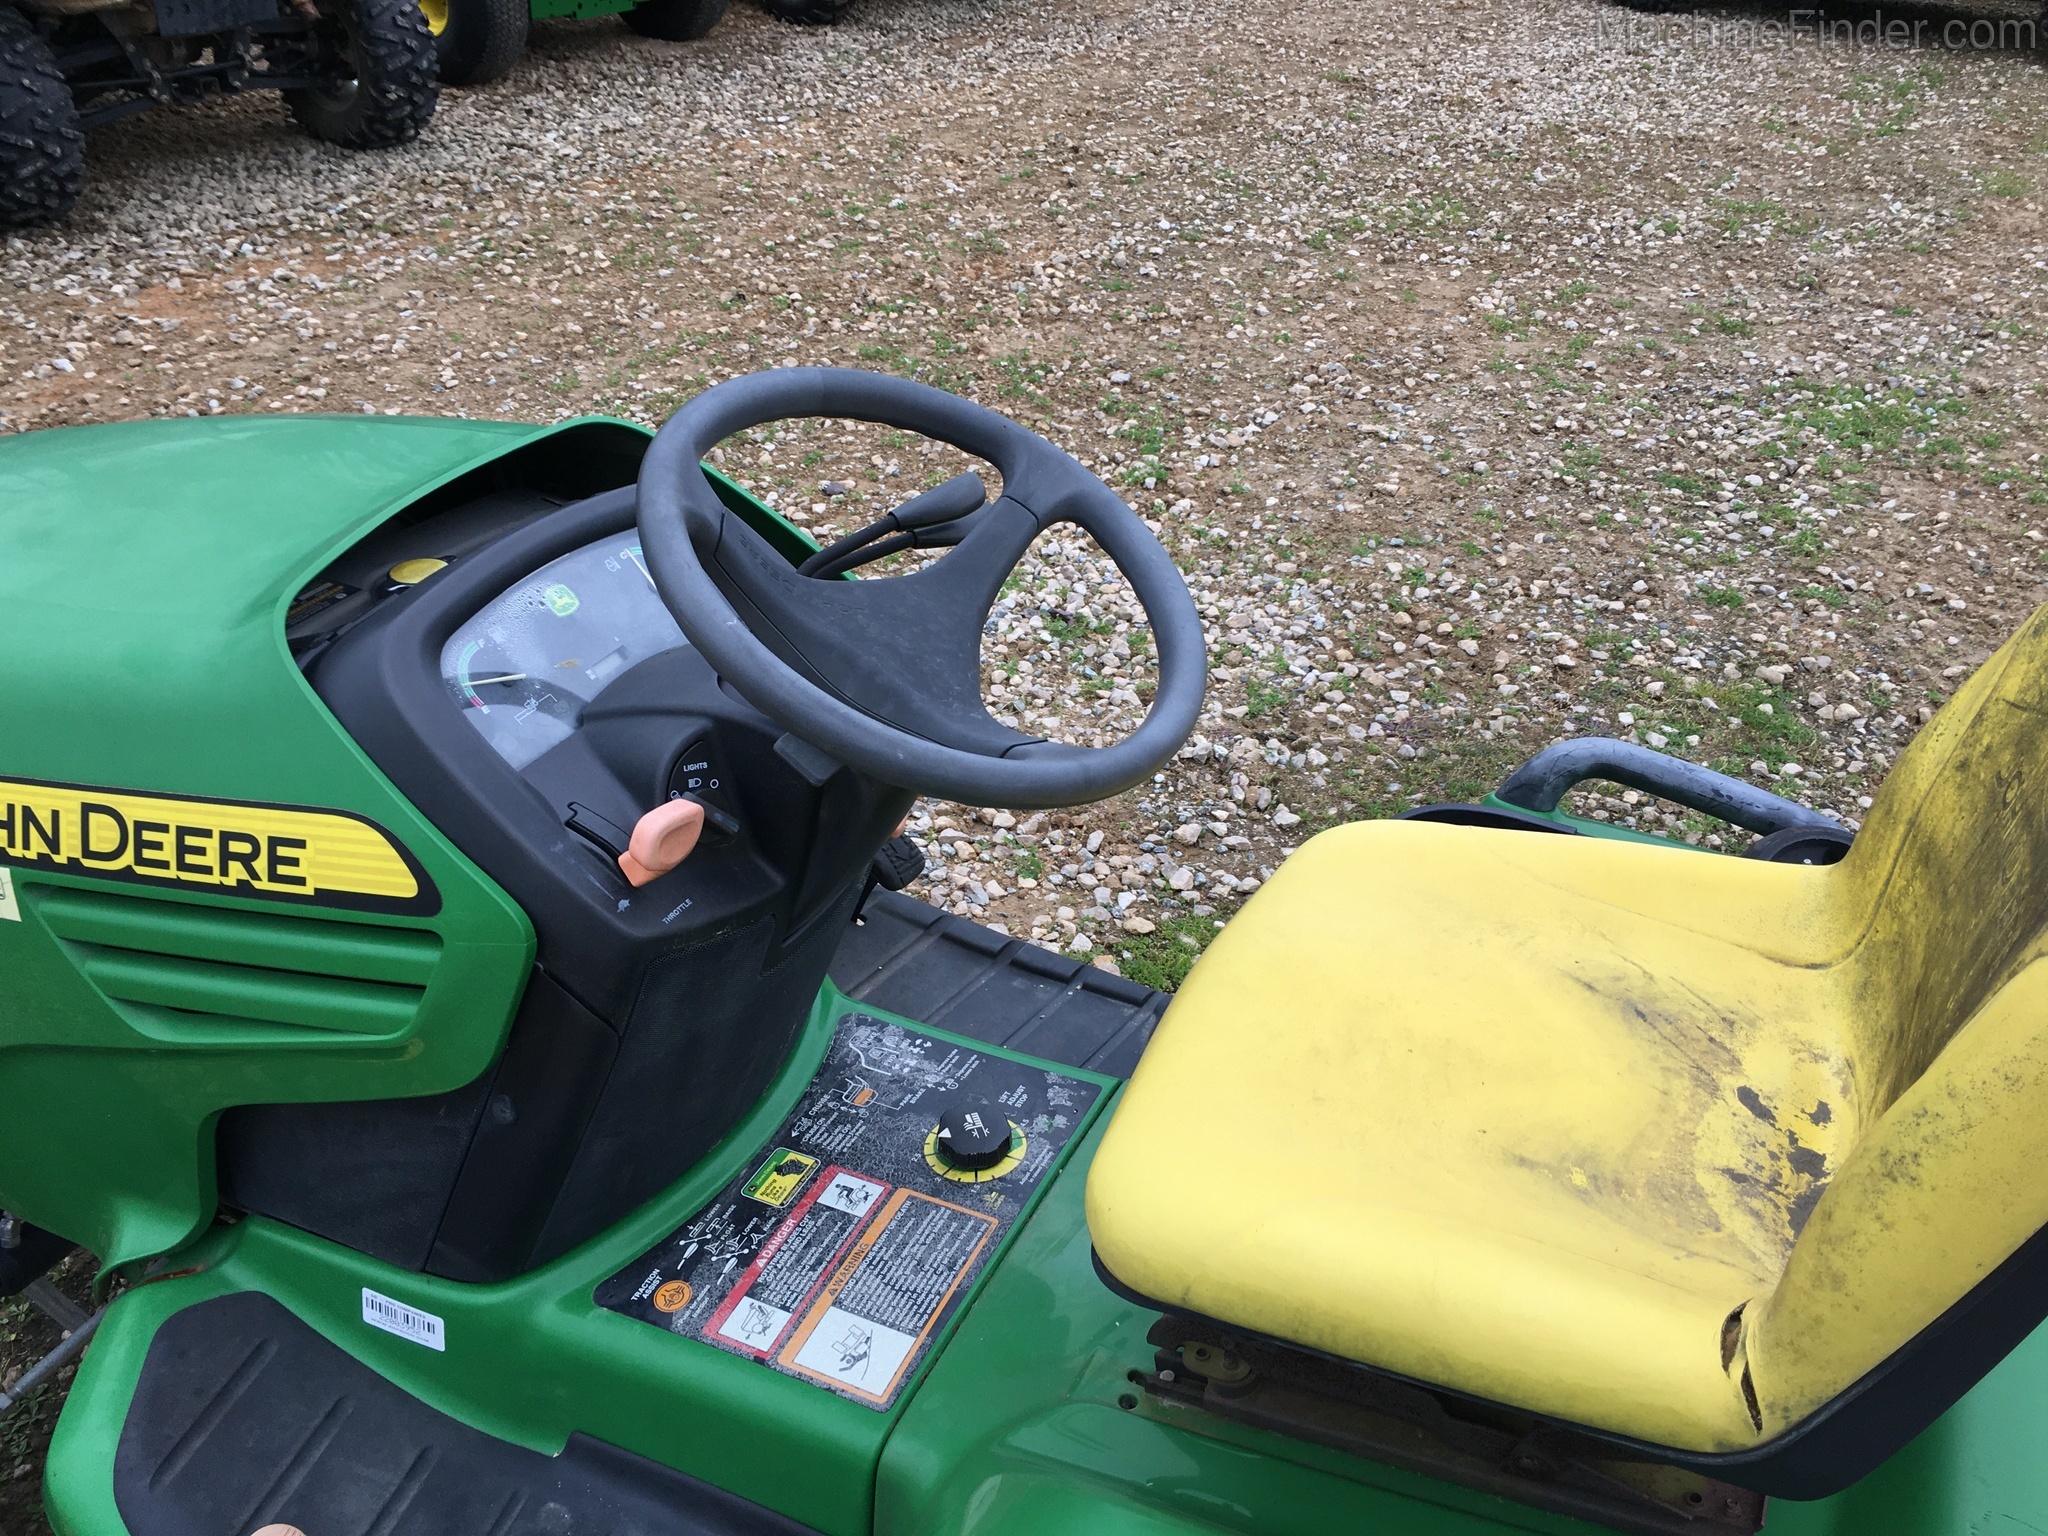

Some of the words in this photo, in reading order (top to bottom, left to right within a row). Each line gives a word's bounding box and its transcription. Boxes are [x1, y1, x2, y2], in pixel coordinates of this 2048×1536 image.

[683, 762, 708, 772] LIGHTS
[81, 802, 306, 886] DEERE
[661, 898, 693, 924] THROTTLE
[899, 1093, 913, 1106] PARK
[909, 1087, 926, 1104] BRAKE
[998, 1090, 1011, 1103] LIFT
[1006, 1084, 1026, 1105] ADJUST
[1014, 1093, 1029, 1107] STOP
[807, 1093, 831, 1116] CRUISE
[1019, 1118, 1030, 1127] 4.5
[910, 1152, 921, 1161] 2.5
[758, 1177, 778, 1196] Nothing
[970, 1184, 981, 1193] 1.5
[703, 1203, 721, 1221] LOWER
[721, 1203, 737, 1218] RAISE
[719, 1223, 736, 1240] FLOAT
[741, 1216, 759, 1235] LOWER
[762, 1216, 777, 1231] RAISE
[761, 1218, 797, 1258] DANGER
[756, 1250, 784, 1282] ROTATING
[780, 1226, 802, 1250] BLADES
[798, 1214, 812, 1227] CUT
[765, 1267, 779, 1281] OFF
[775, 1250, 792, 1268] ARMS
[788, 1236, 803, 1250] AND
[799, 1219, 815, 1236] LEGS
[837, 1278, 856, 1298] AVOID
[852, 1250, 876, 1278] SERIOUS
[871, 1229, 891, 1251] INJURY
[887, 1219, 898, 1229] OR
[894, 1200, 912, 1220] DEATH
[830, 1241, 870, 1287] WARNING
[629, 1268, 661, 1301] TRACTION
[640, 1274, 664, 1299] ASSIST
